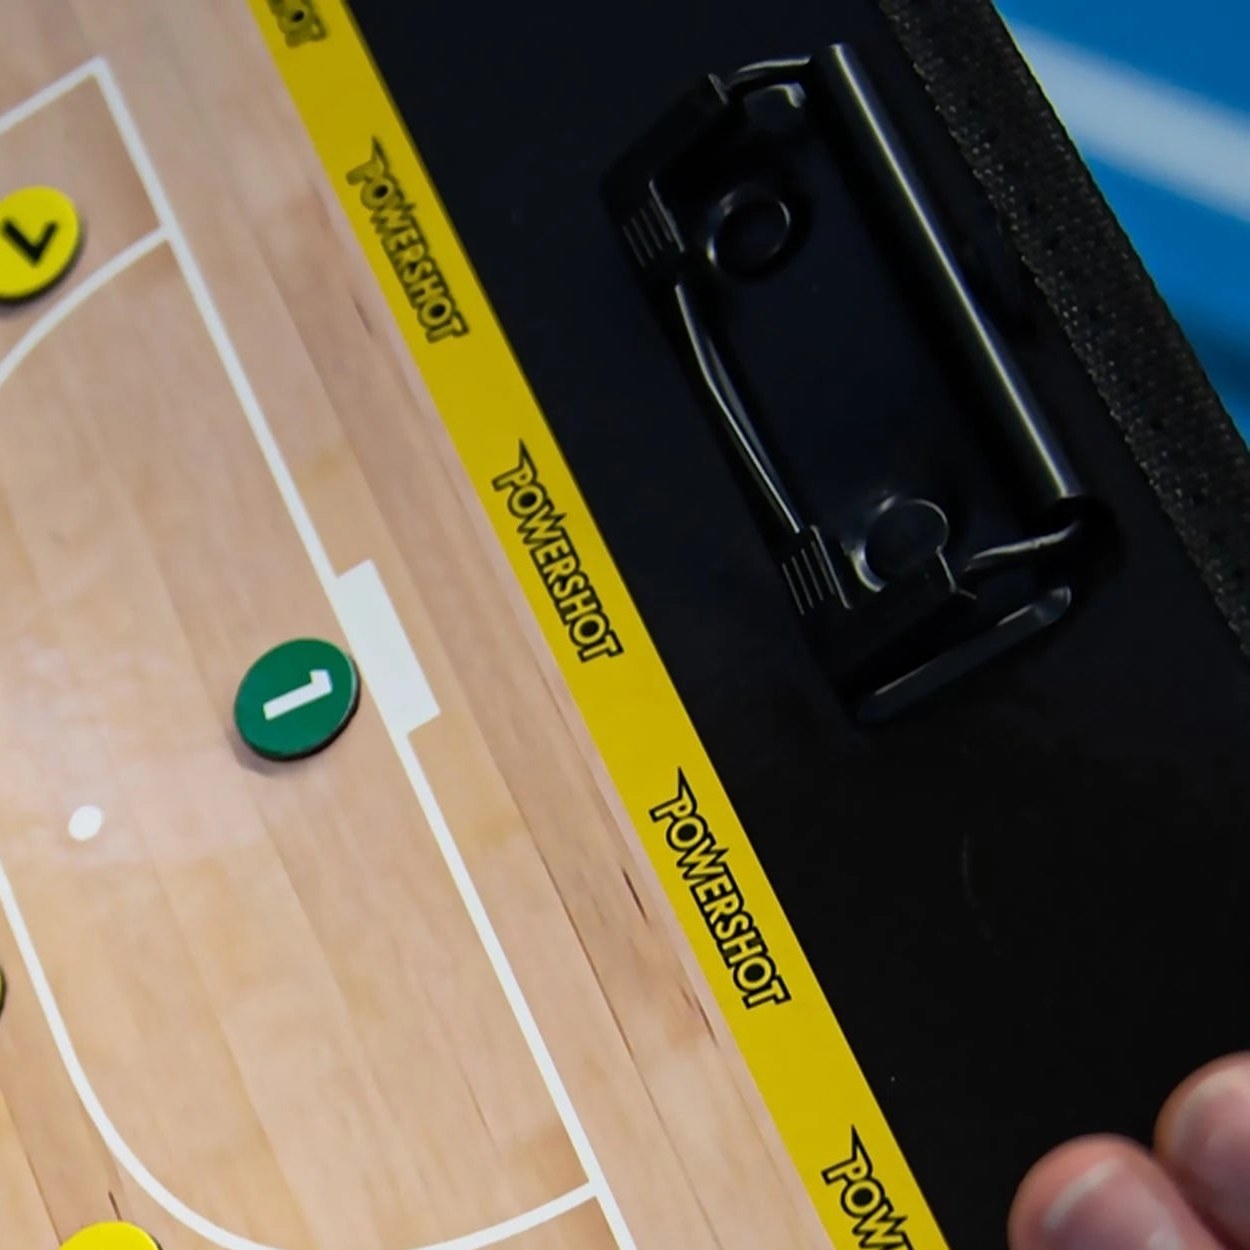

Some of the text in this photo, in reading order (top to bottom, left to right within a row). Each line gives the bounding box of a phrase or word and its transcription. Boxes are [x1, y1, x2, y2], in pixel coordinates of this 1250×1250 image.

[0, 217, 60, 268] 7
[346, 135, 470, 344] POWERSHOT
[492, 438, 625, 664] POWERSHOT
[263, 670, 332, 720] 1
[648, 766, 792, 1009] POWERSHOT
